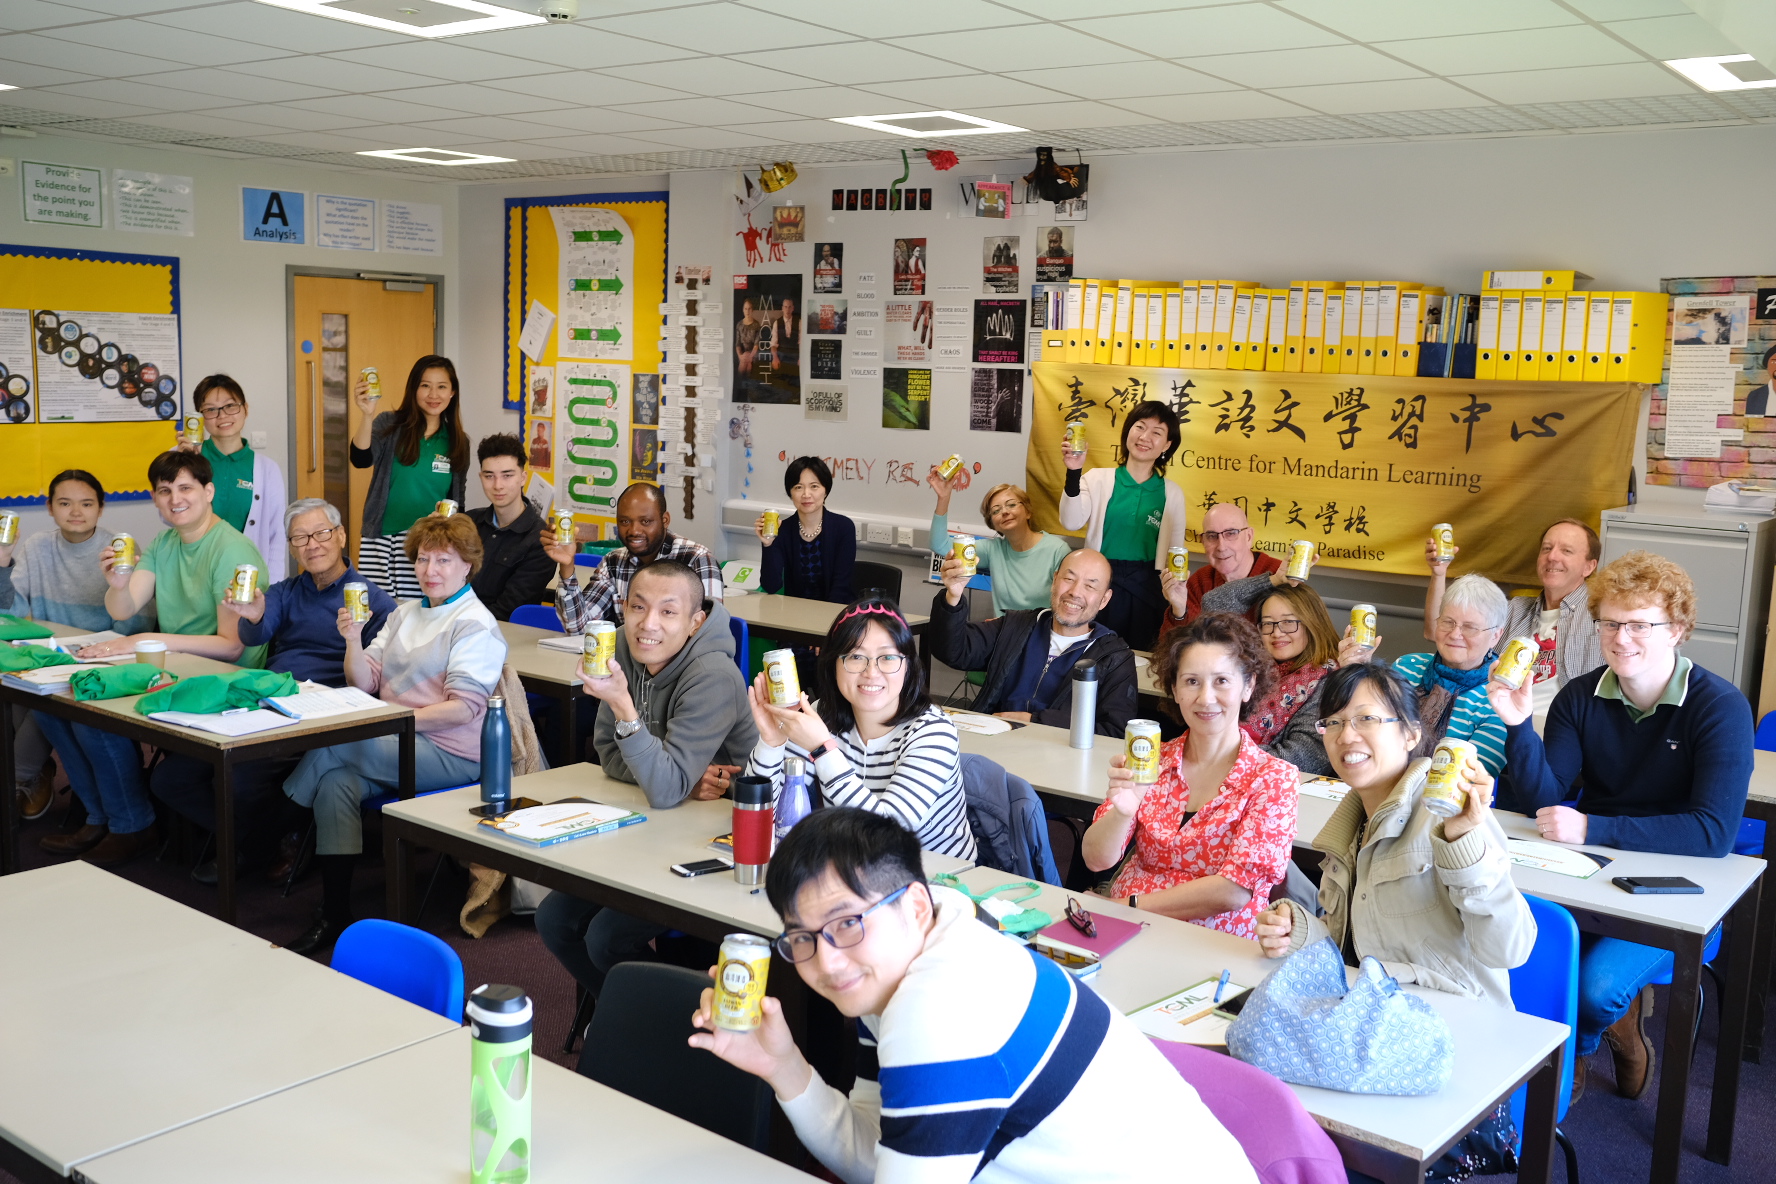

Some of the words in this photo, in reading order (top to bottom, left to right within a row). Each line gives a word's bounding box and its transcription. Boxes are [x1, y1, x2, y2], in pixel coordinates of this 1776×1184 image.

[45, 167, 80, 180] Provide
[35, 180, 76, 192] Evidence
[78, 184, 92, 193] for
[33, 193, 48, 202] the
[52, 194, 76, 205] point
[78, 198, 94, 208] you
[38, 208, 52, 216] are
[55, 208, 92, 221] making.
[261, 191, 289, 226] A
[253, 227, 297, 240] Analysis
[1714, 299, 1736, 307] Tower
[758, 294, 774, 384] MACBETH
[805, 398, 842, 406] SCORPIONS
[833, 392, 843, 400] OF
[1181, 450, 1241, 471] Centre
[1248, 454, 1276, 474] for
[1282, 456, 1378, 482] Mandarin
[1386, 462, 1482, 494] Learning
[1318, 541, 1385, 562] Paradise
[1153, 995, 1208, 1014] TCML
